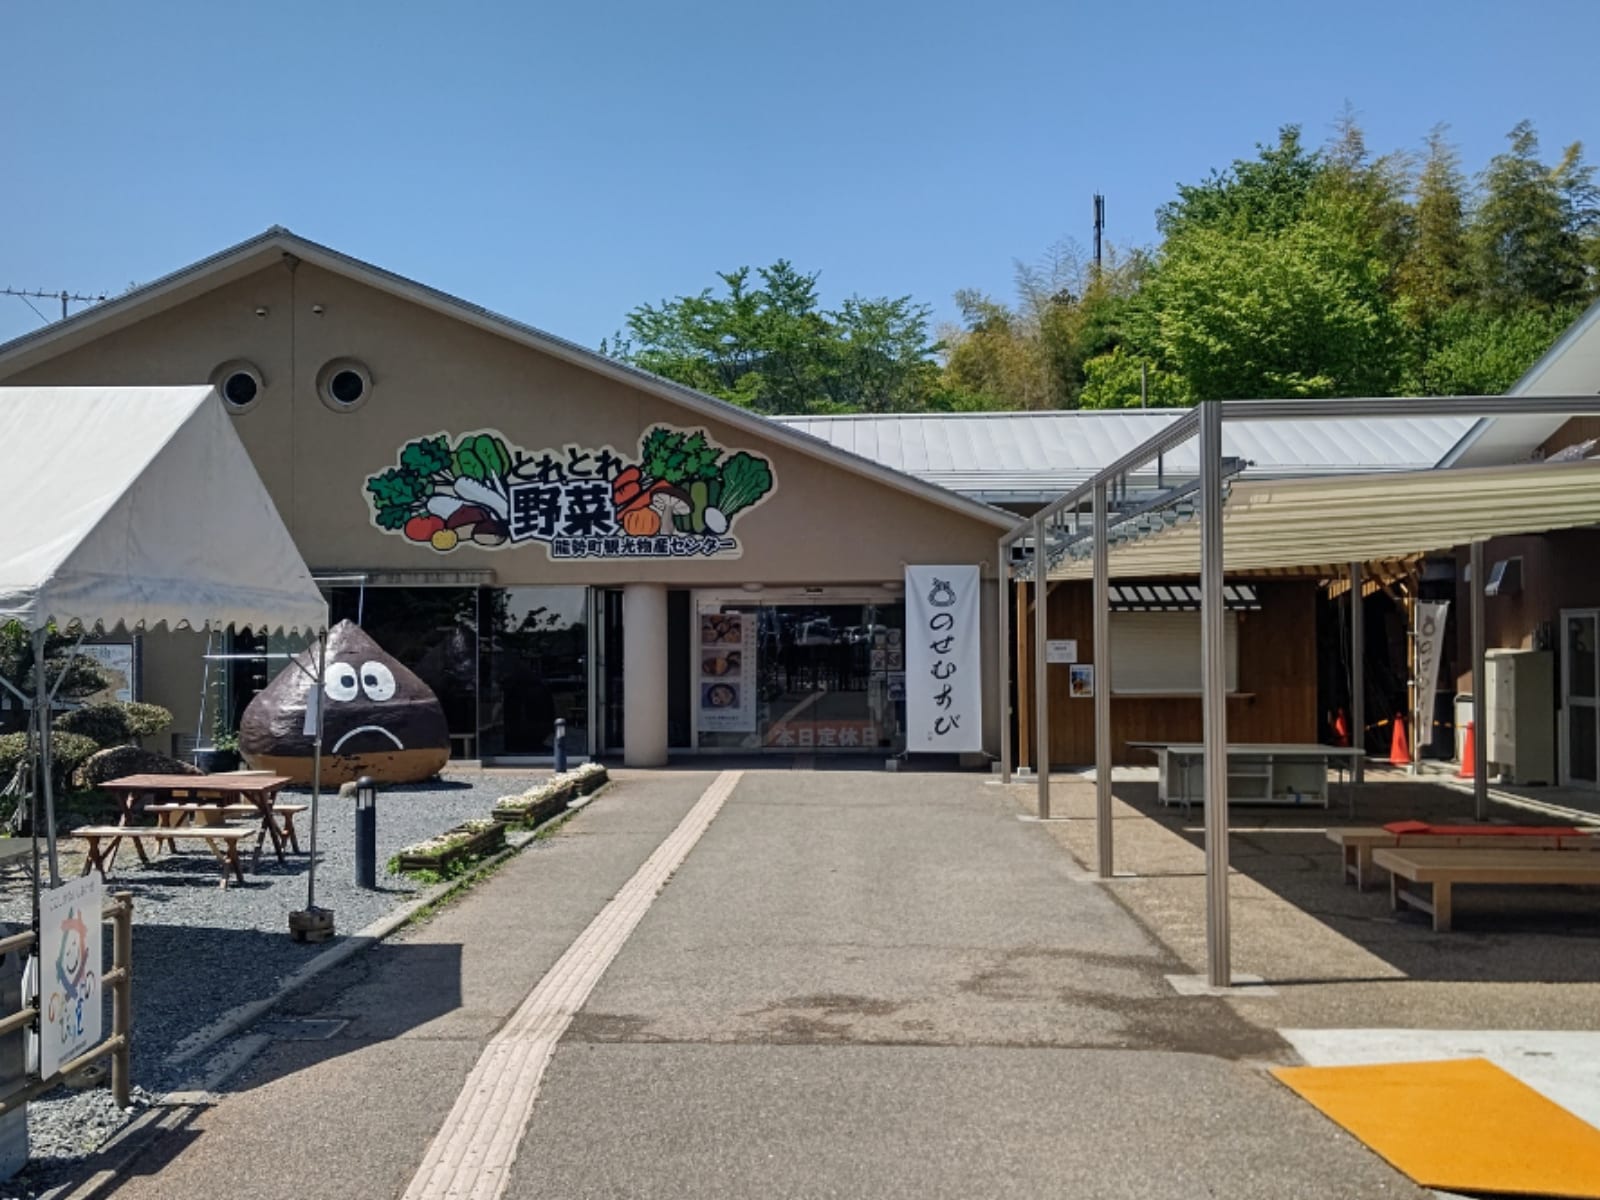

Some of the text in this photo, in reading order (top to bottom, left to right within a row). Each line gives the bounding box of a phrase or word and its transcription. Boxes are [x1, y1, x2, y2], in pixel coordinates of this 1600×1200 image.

[511, 447, 623, 484] とれとれ
[512, 483, 615, 537] 野菜
[553, 536, 737, 558] 能勢町観光物産センター
[775, 727, 878, 747] 本日定休日
